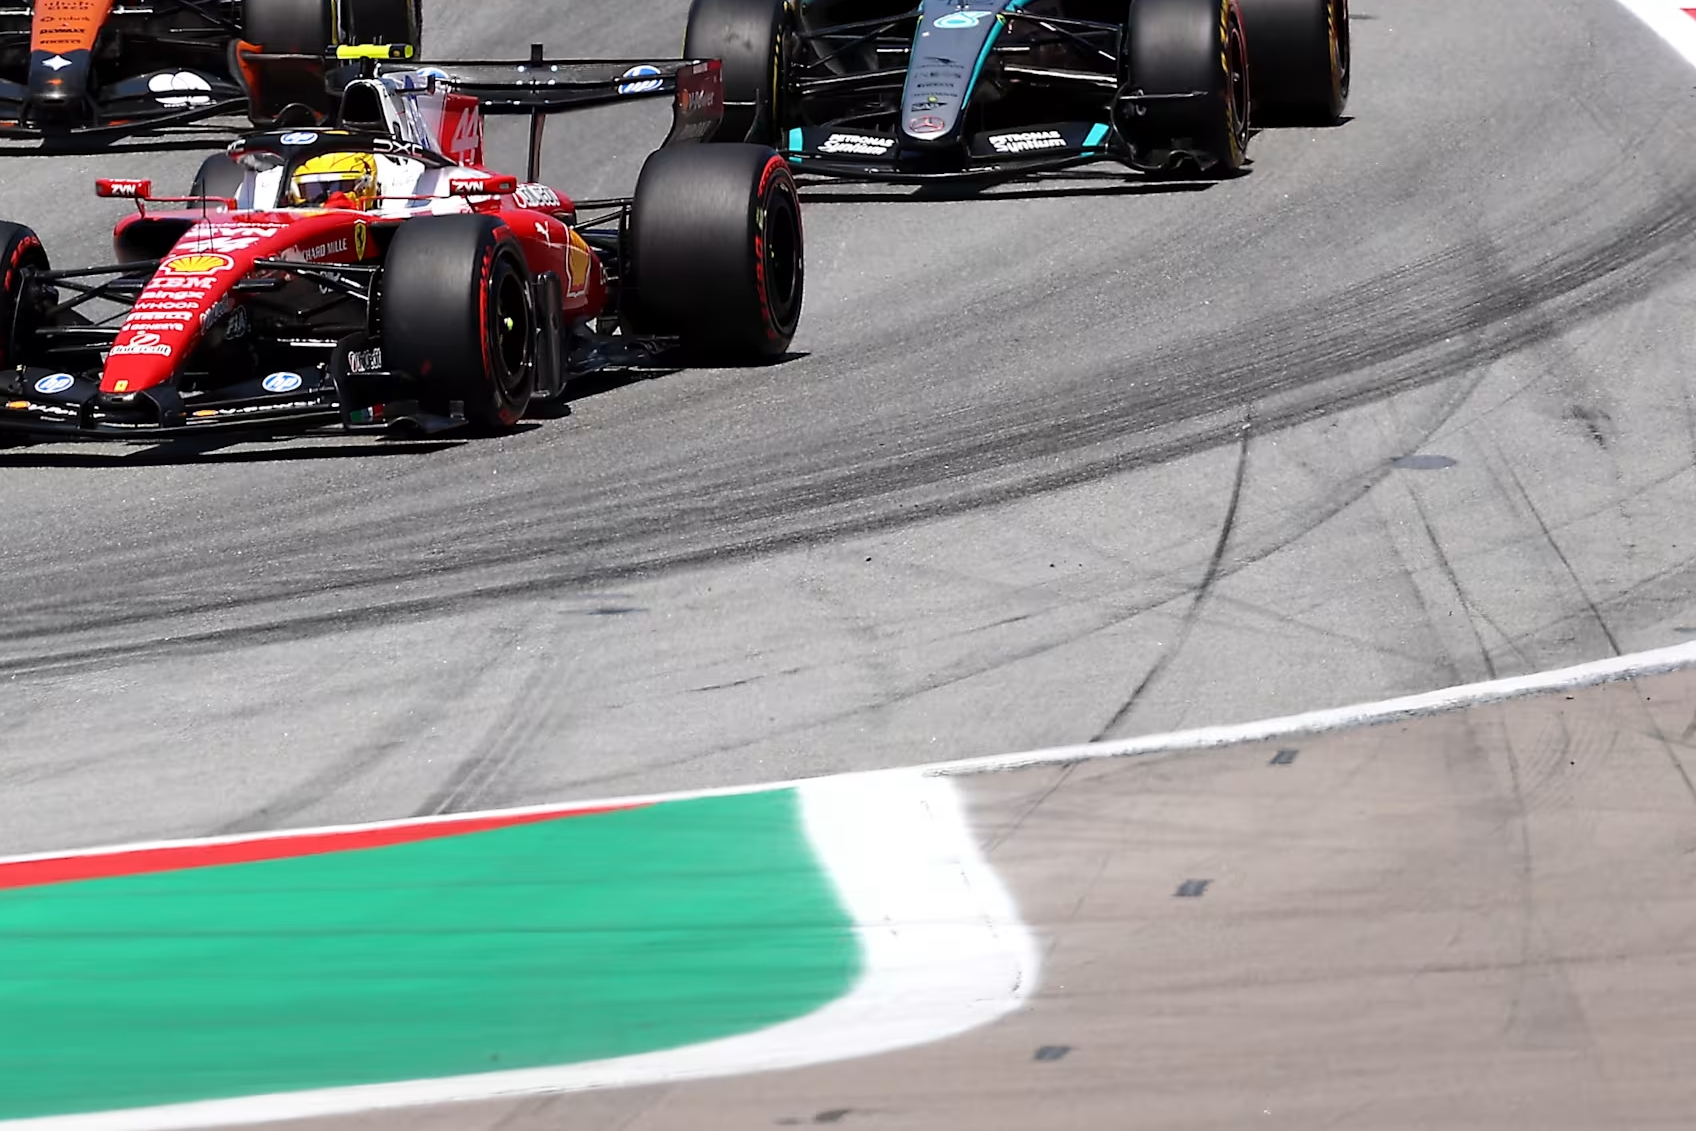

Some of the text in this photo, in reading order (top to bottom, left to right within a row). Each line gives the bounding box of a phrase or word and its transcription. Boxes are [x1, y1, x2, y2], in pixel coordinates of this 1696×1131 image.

[452, 106, 480, 166] 44
[829, 133, 894, 148] PETRONAS
[989, 130, 1062, 145] PETRONAS
[111, 183, 137, 195] ZYN
[326, 238, 349, 257] MILLE
[145, 277, 219, 290] IBM
[133, 301, 200, 311] WHOOP
